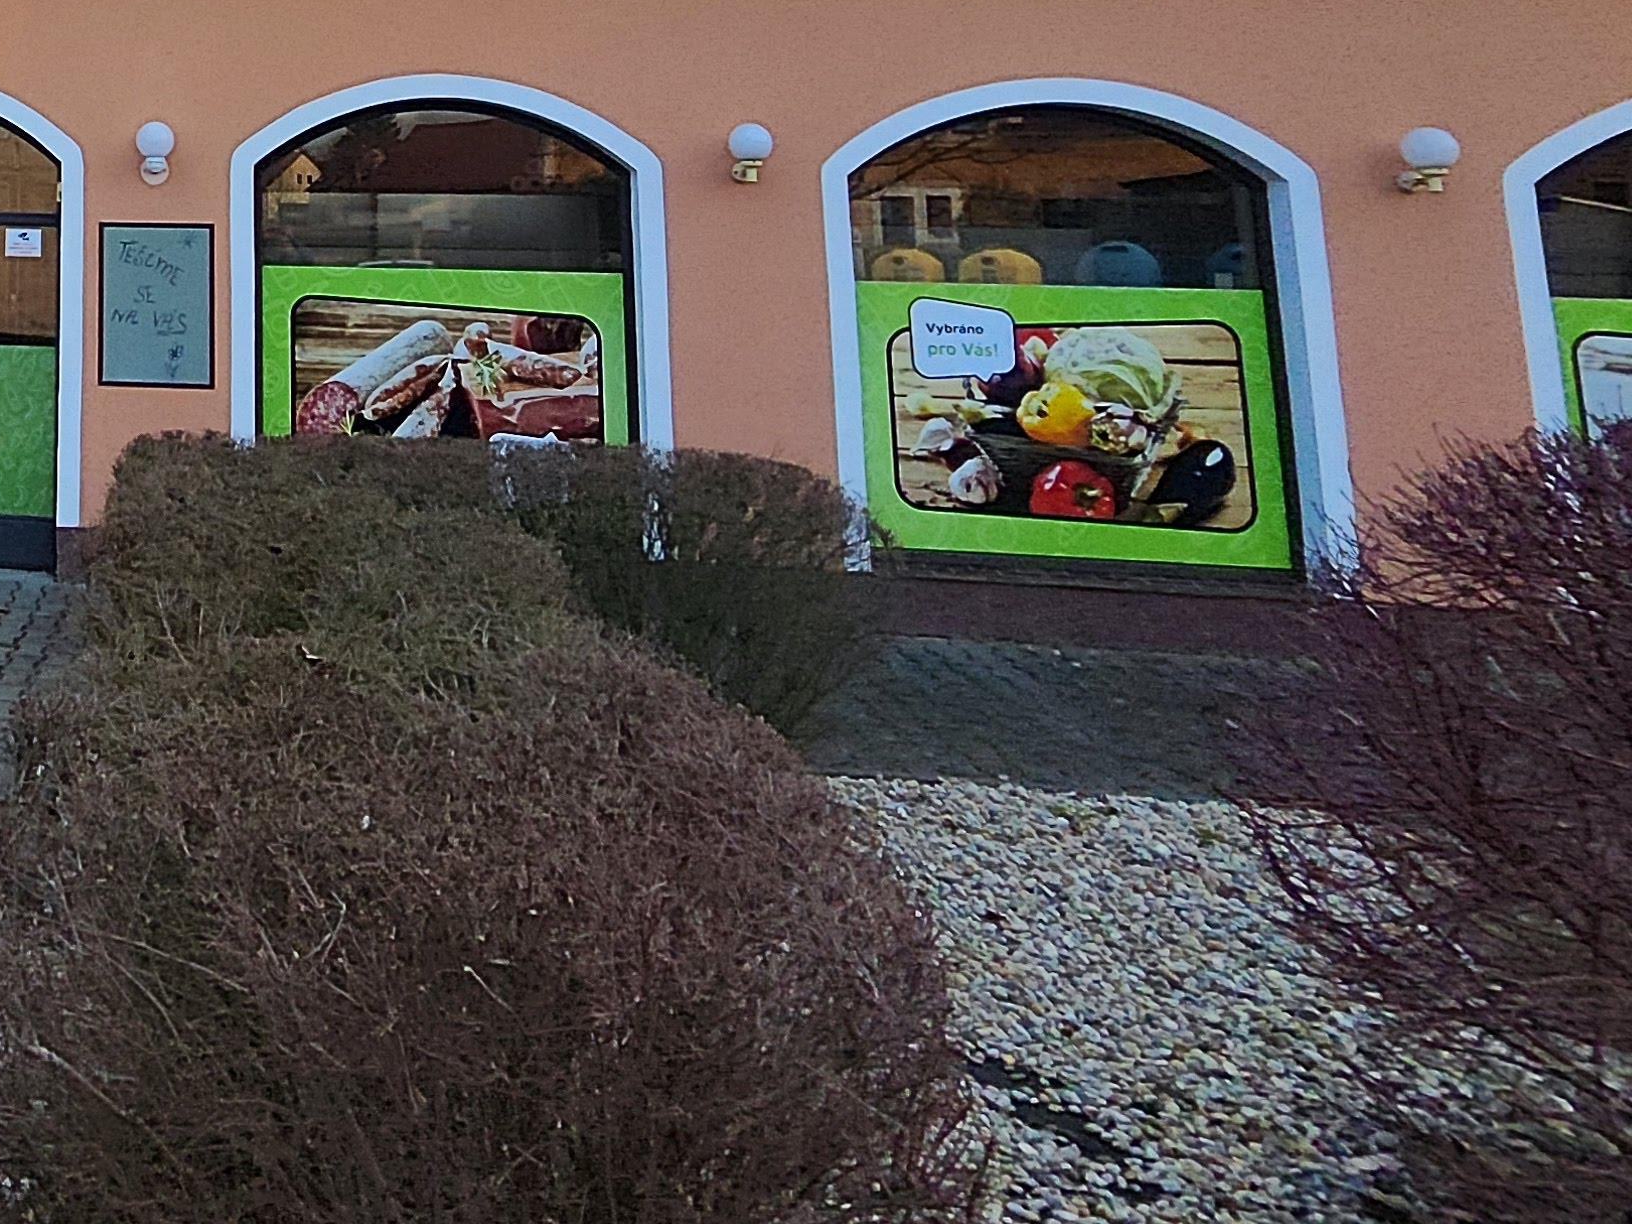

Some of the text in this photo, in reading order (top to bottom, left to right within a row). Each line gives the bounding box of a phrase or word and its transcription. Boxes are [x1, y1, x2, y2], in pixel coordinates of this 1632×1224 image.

[134, 285, 156, 304] SE
[926, 322, 984, 336] Vybráno
[928, 342, 998, 358] pro Vás!
